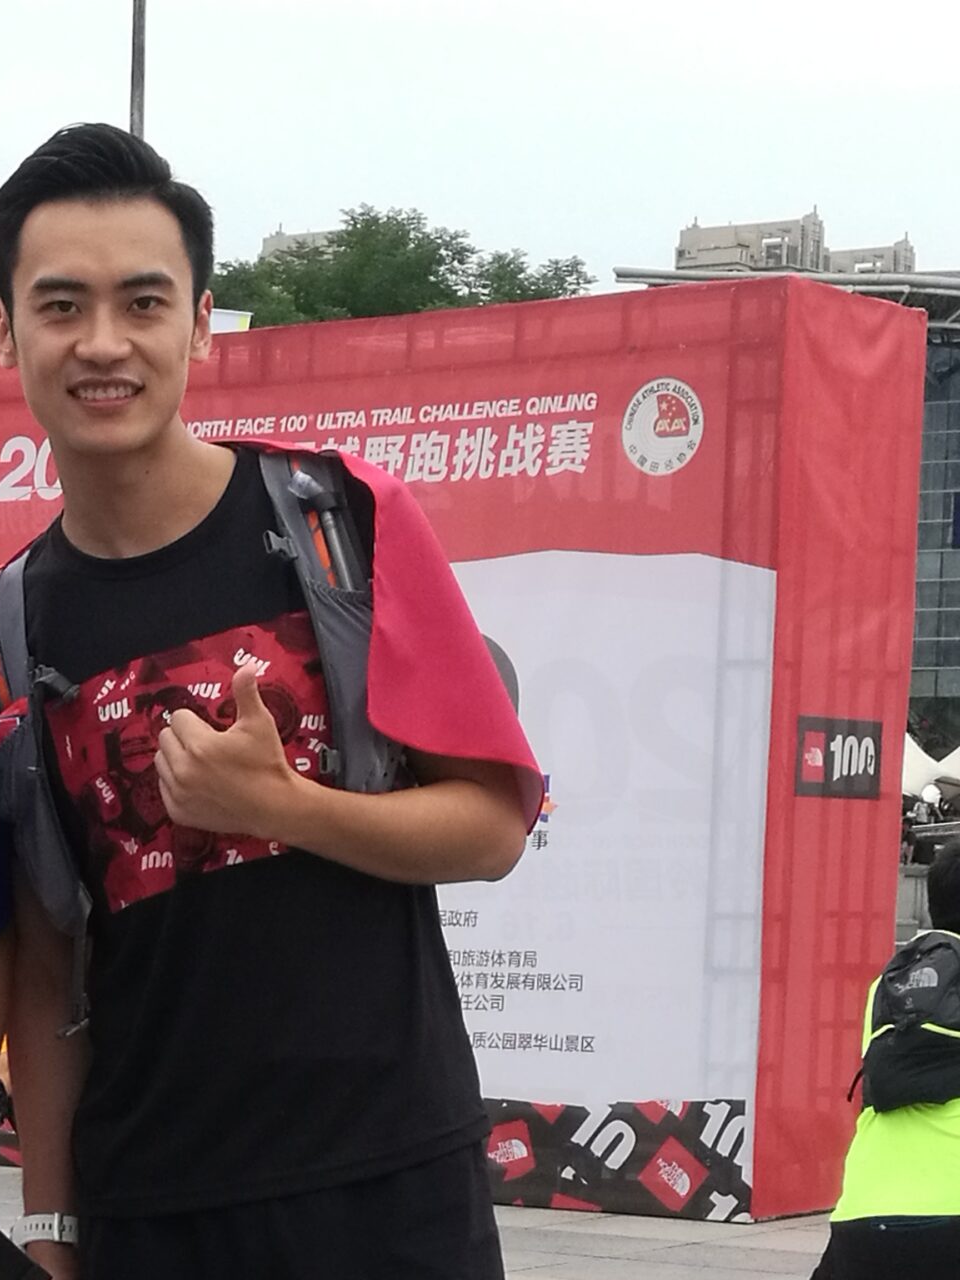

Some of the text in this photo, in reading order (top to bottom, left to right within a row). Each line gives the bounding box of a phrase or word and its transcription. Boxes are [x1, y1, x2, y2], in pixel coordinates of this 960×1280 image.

[234, 416, 276, 436] FACE
[316, 410, 366, 430] ULTRA
[371, 407, 416, 427] TRAIL
[526, 392, 598, 414] QINLING
[830, 734, 875, 781] 100
[448, 950, 537, 967] 和旅游体育局
